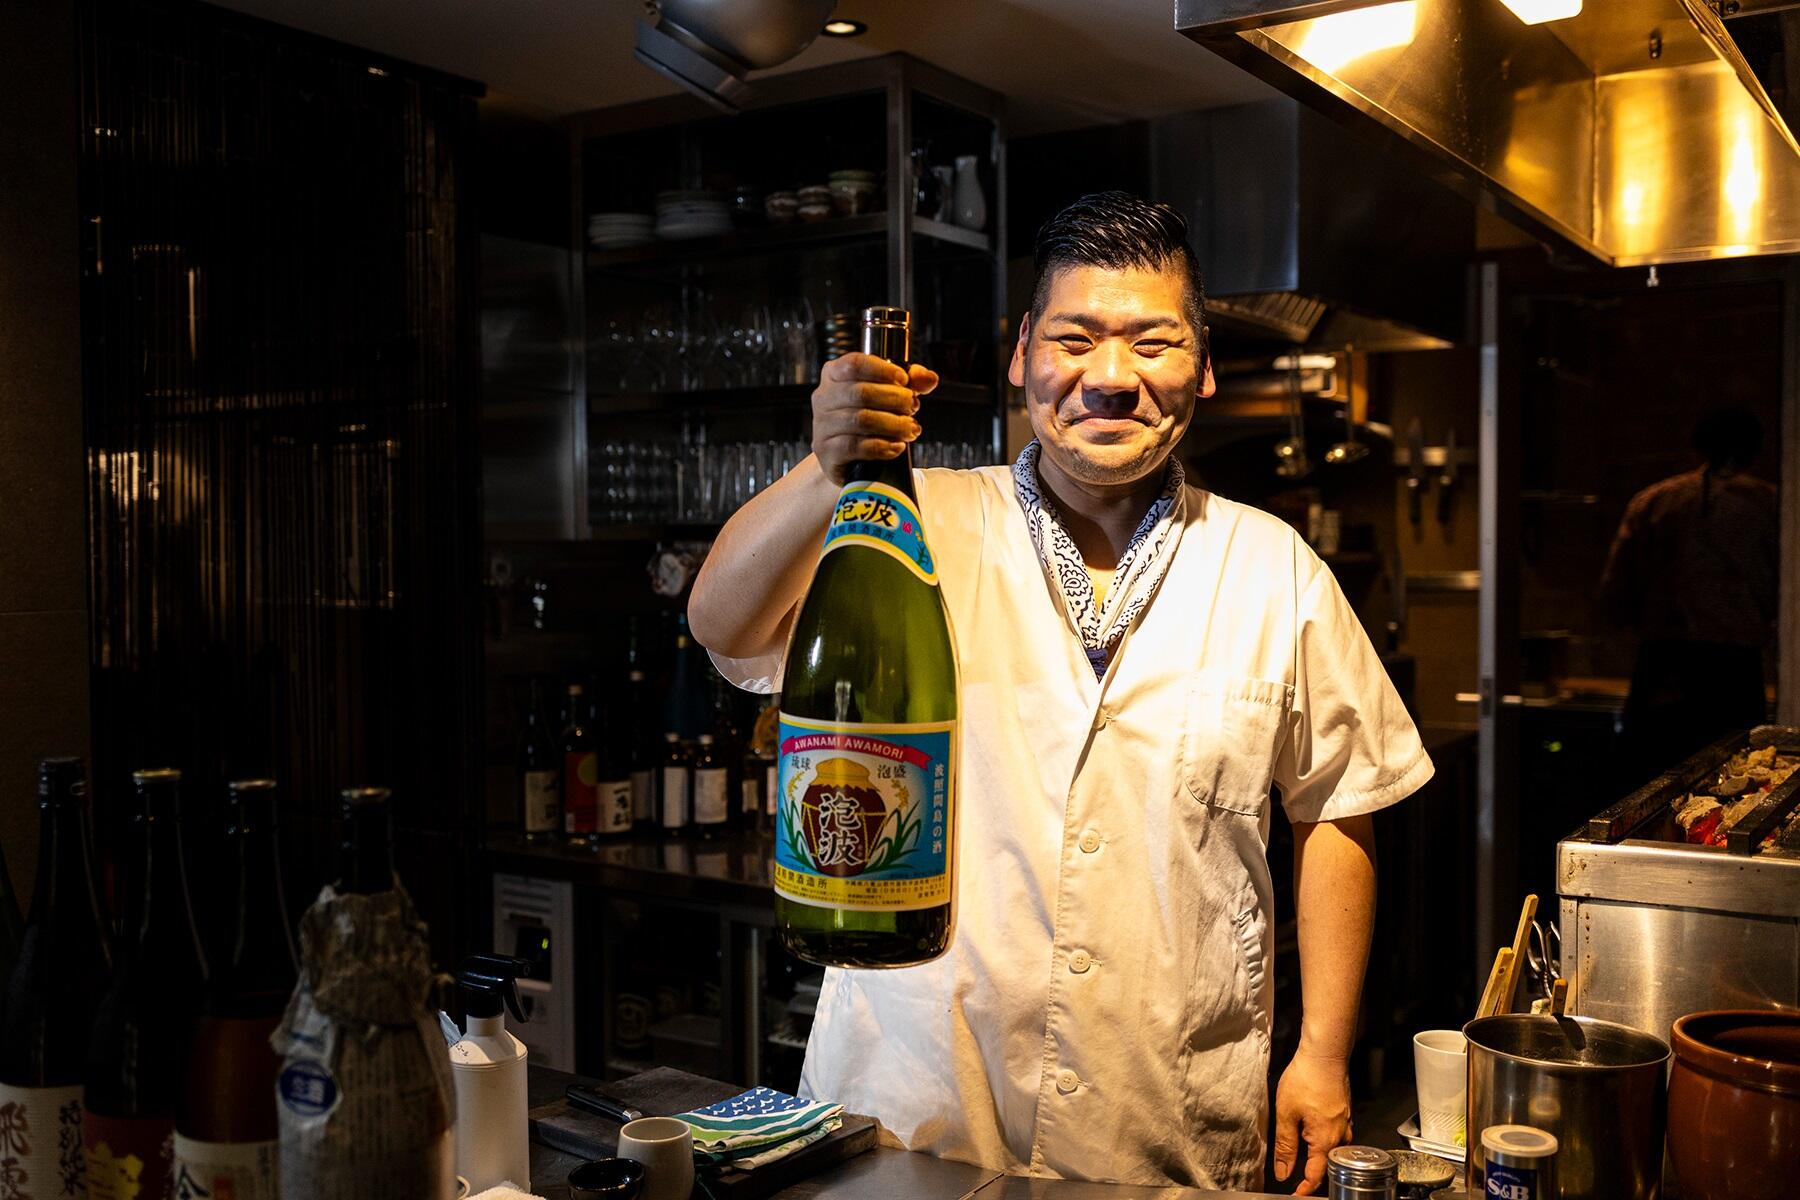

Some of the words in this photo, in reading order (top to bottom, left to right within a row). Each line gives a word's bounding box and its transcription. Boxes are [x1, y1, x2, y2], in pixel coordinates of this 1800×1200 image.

[794, 735, 841, 751] AWANAMI
[845, 737, 904, 760] AWAMORI
[791, 755, 812, 771] 琉球
[877, 764, 907, 779] 泡盛
[817, 791, 863, 867] 泡波
[1487, 1176, 1531, 1200] S&B
